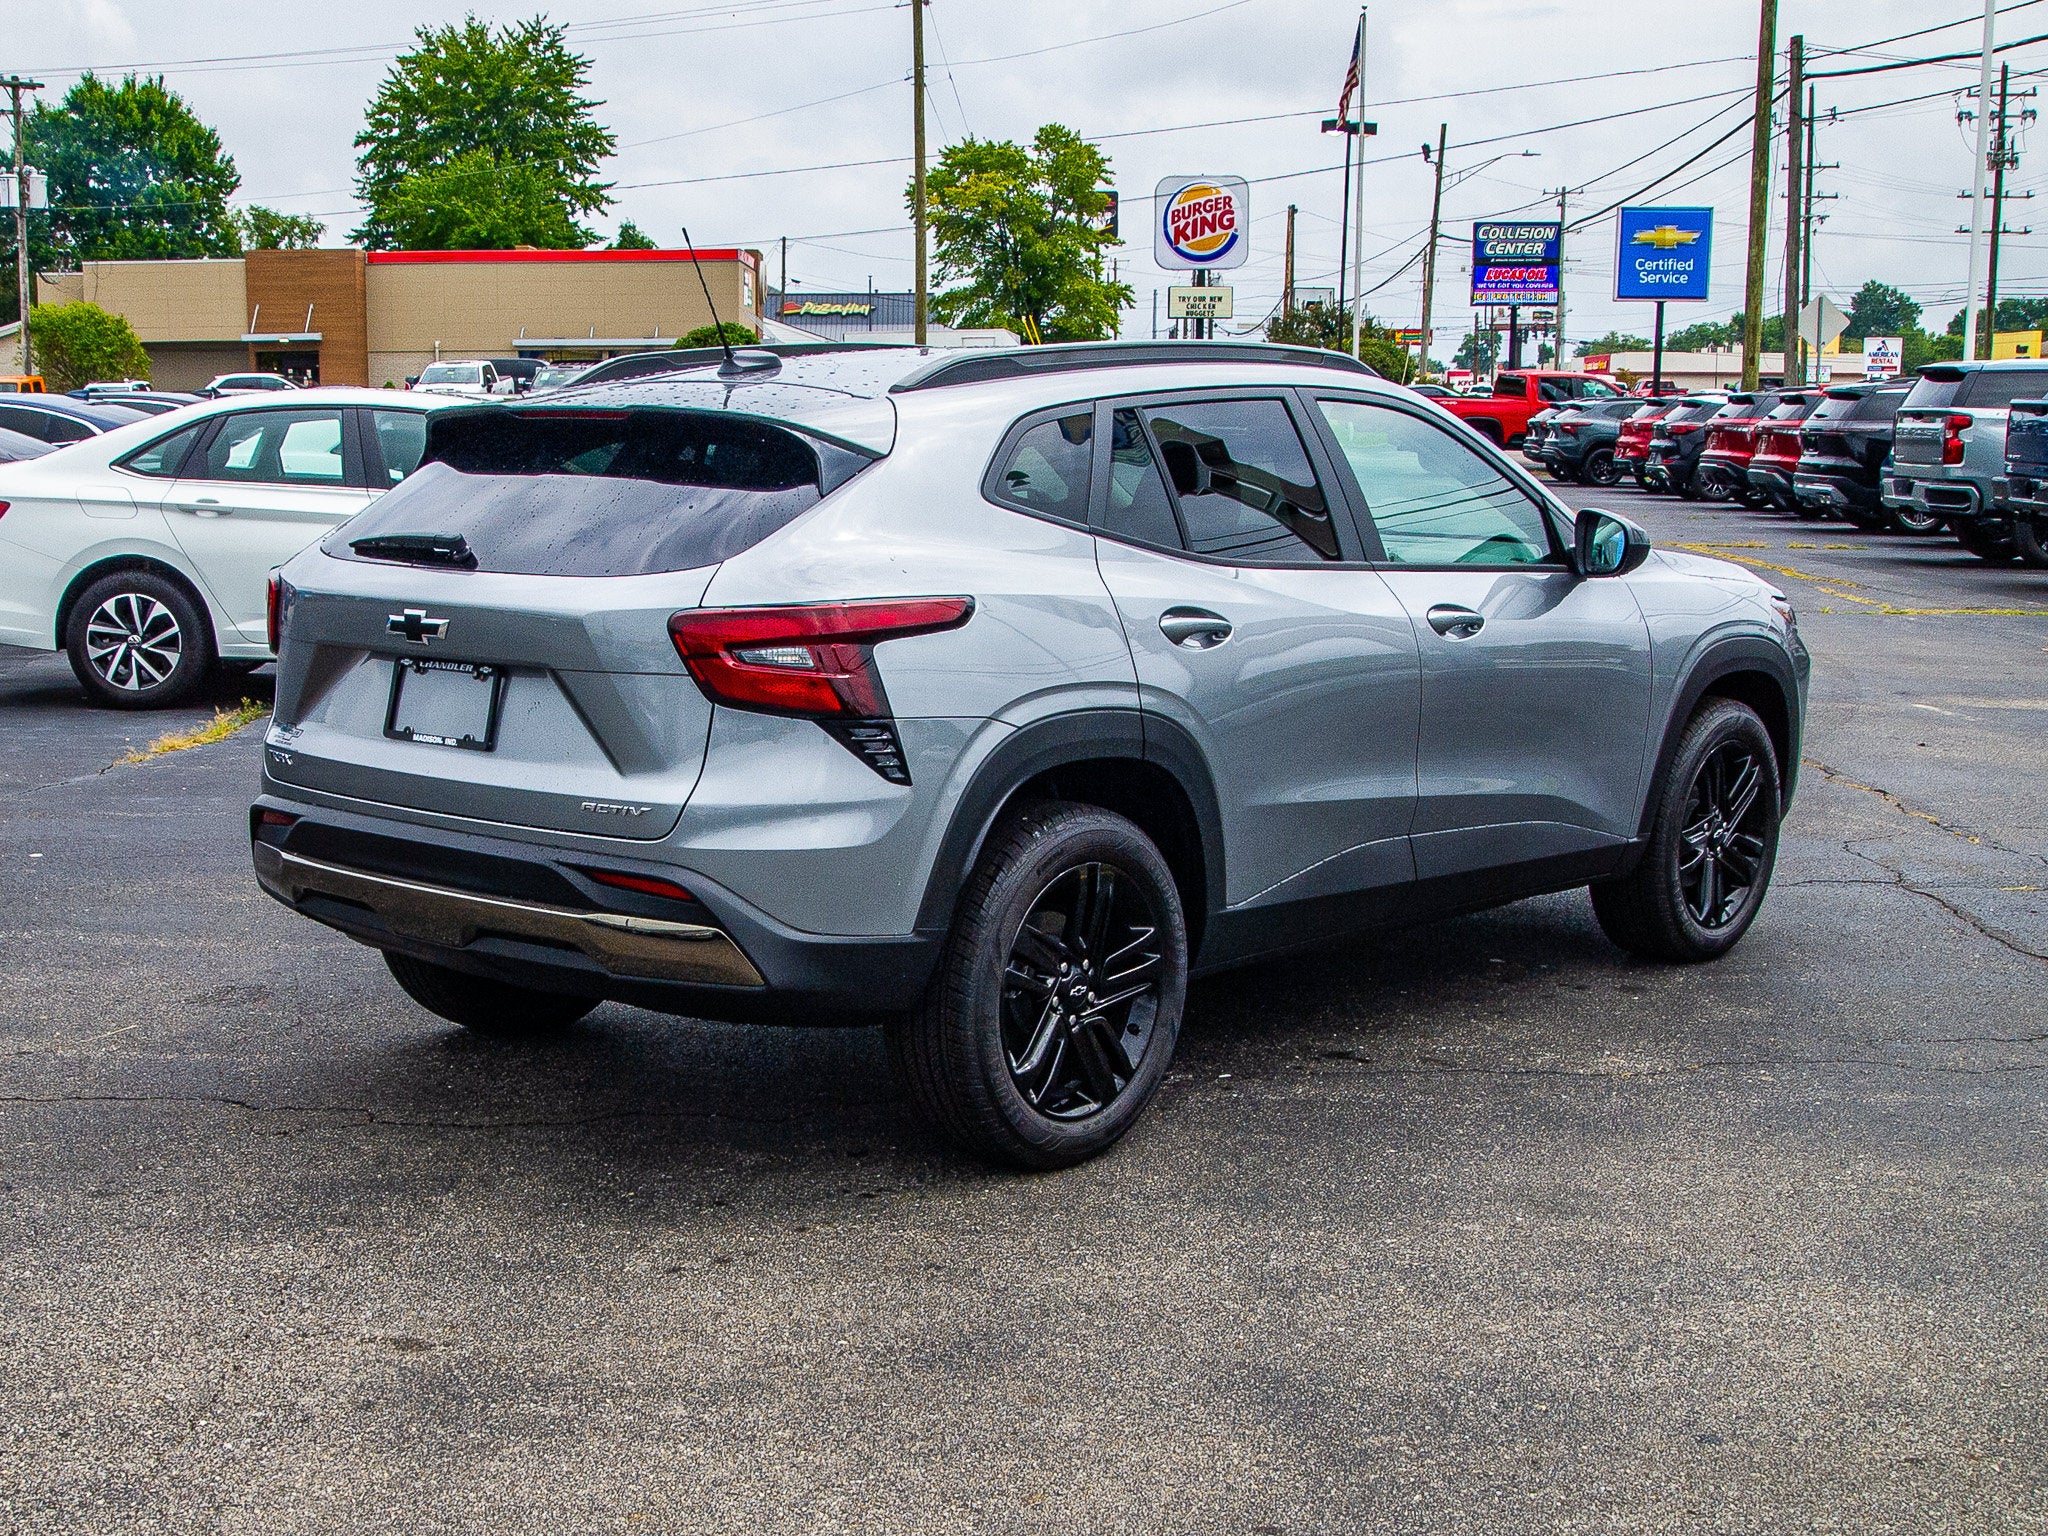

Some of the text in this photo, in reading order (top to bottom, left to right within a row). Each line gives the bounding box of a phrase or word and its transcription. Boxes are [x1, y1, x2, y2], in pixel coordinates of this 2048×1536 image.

[1171, 195, 1233, 226] BURGER
[1173, 209, 1235, 246] KING
[1477, 225, 1557, 240] COLLISION
[1485, 241, 1545, 255] CENTER
[1635, 258, 1694, 271] Certified
[1485, 267, 1547, 281] LUCAS OIL
[1639, 272, 1688, 285] Service
[801, 301, 841, 315] Pizza
[581, 801, 652, 816] ACTIV
